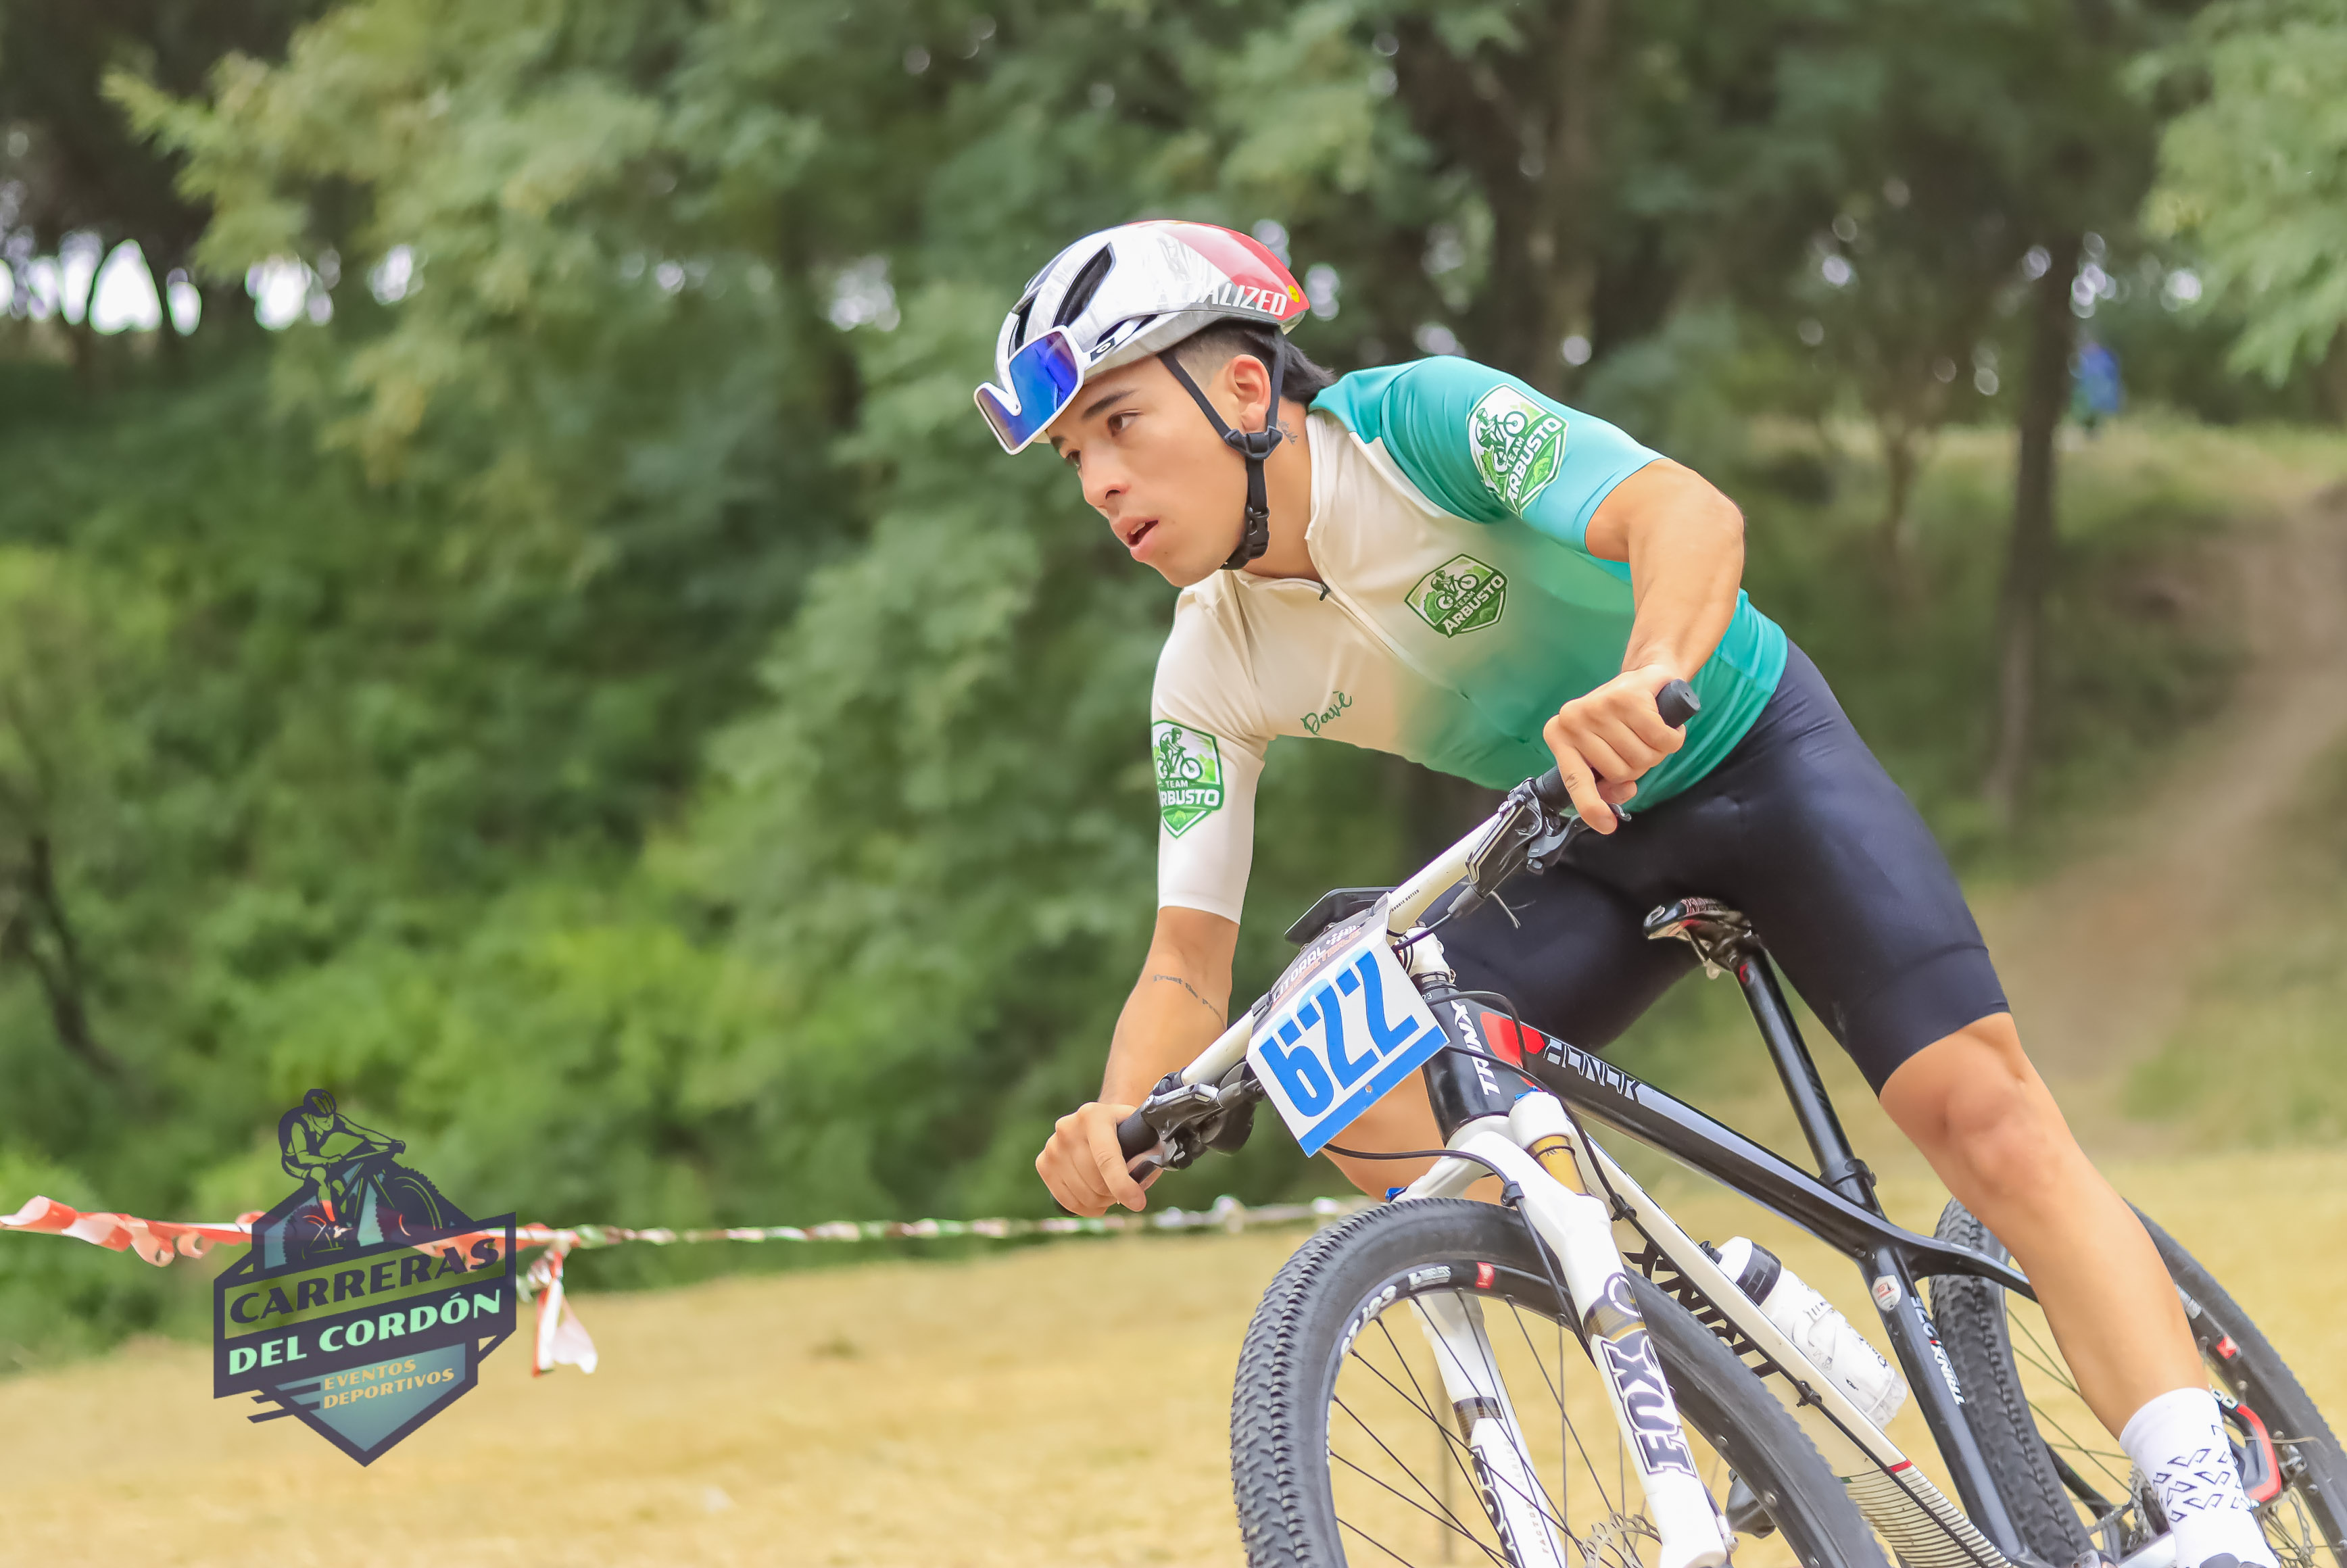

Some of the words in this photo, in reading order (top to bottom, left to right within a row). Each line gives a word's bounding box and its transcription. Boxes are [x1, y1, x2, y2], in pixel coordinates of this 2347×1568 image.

[1201, 282, 1288, 316] ALIZED
[1507, 437, 1525, 468] TEAM
[1507, 417, 1562, 508] ARBUSTO
[1442, 575, 1504, 635] ARBUSTO
[1453, 591, 1475, 608] TEAM
[1160, 789, 1220, 807] RBUSTO
[1166, 780, 1188, 788] TEAM
[1273, 946, 1326, 1002] LITORAL
[1257, 946, 1421, 1118] 622
[1451, 1000, 1501, 1096] TRINX
[1601, 1336, 1697, 1478] FOX
